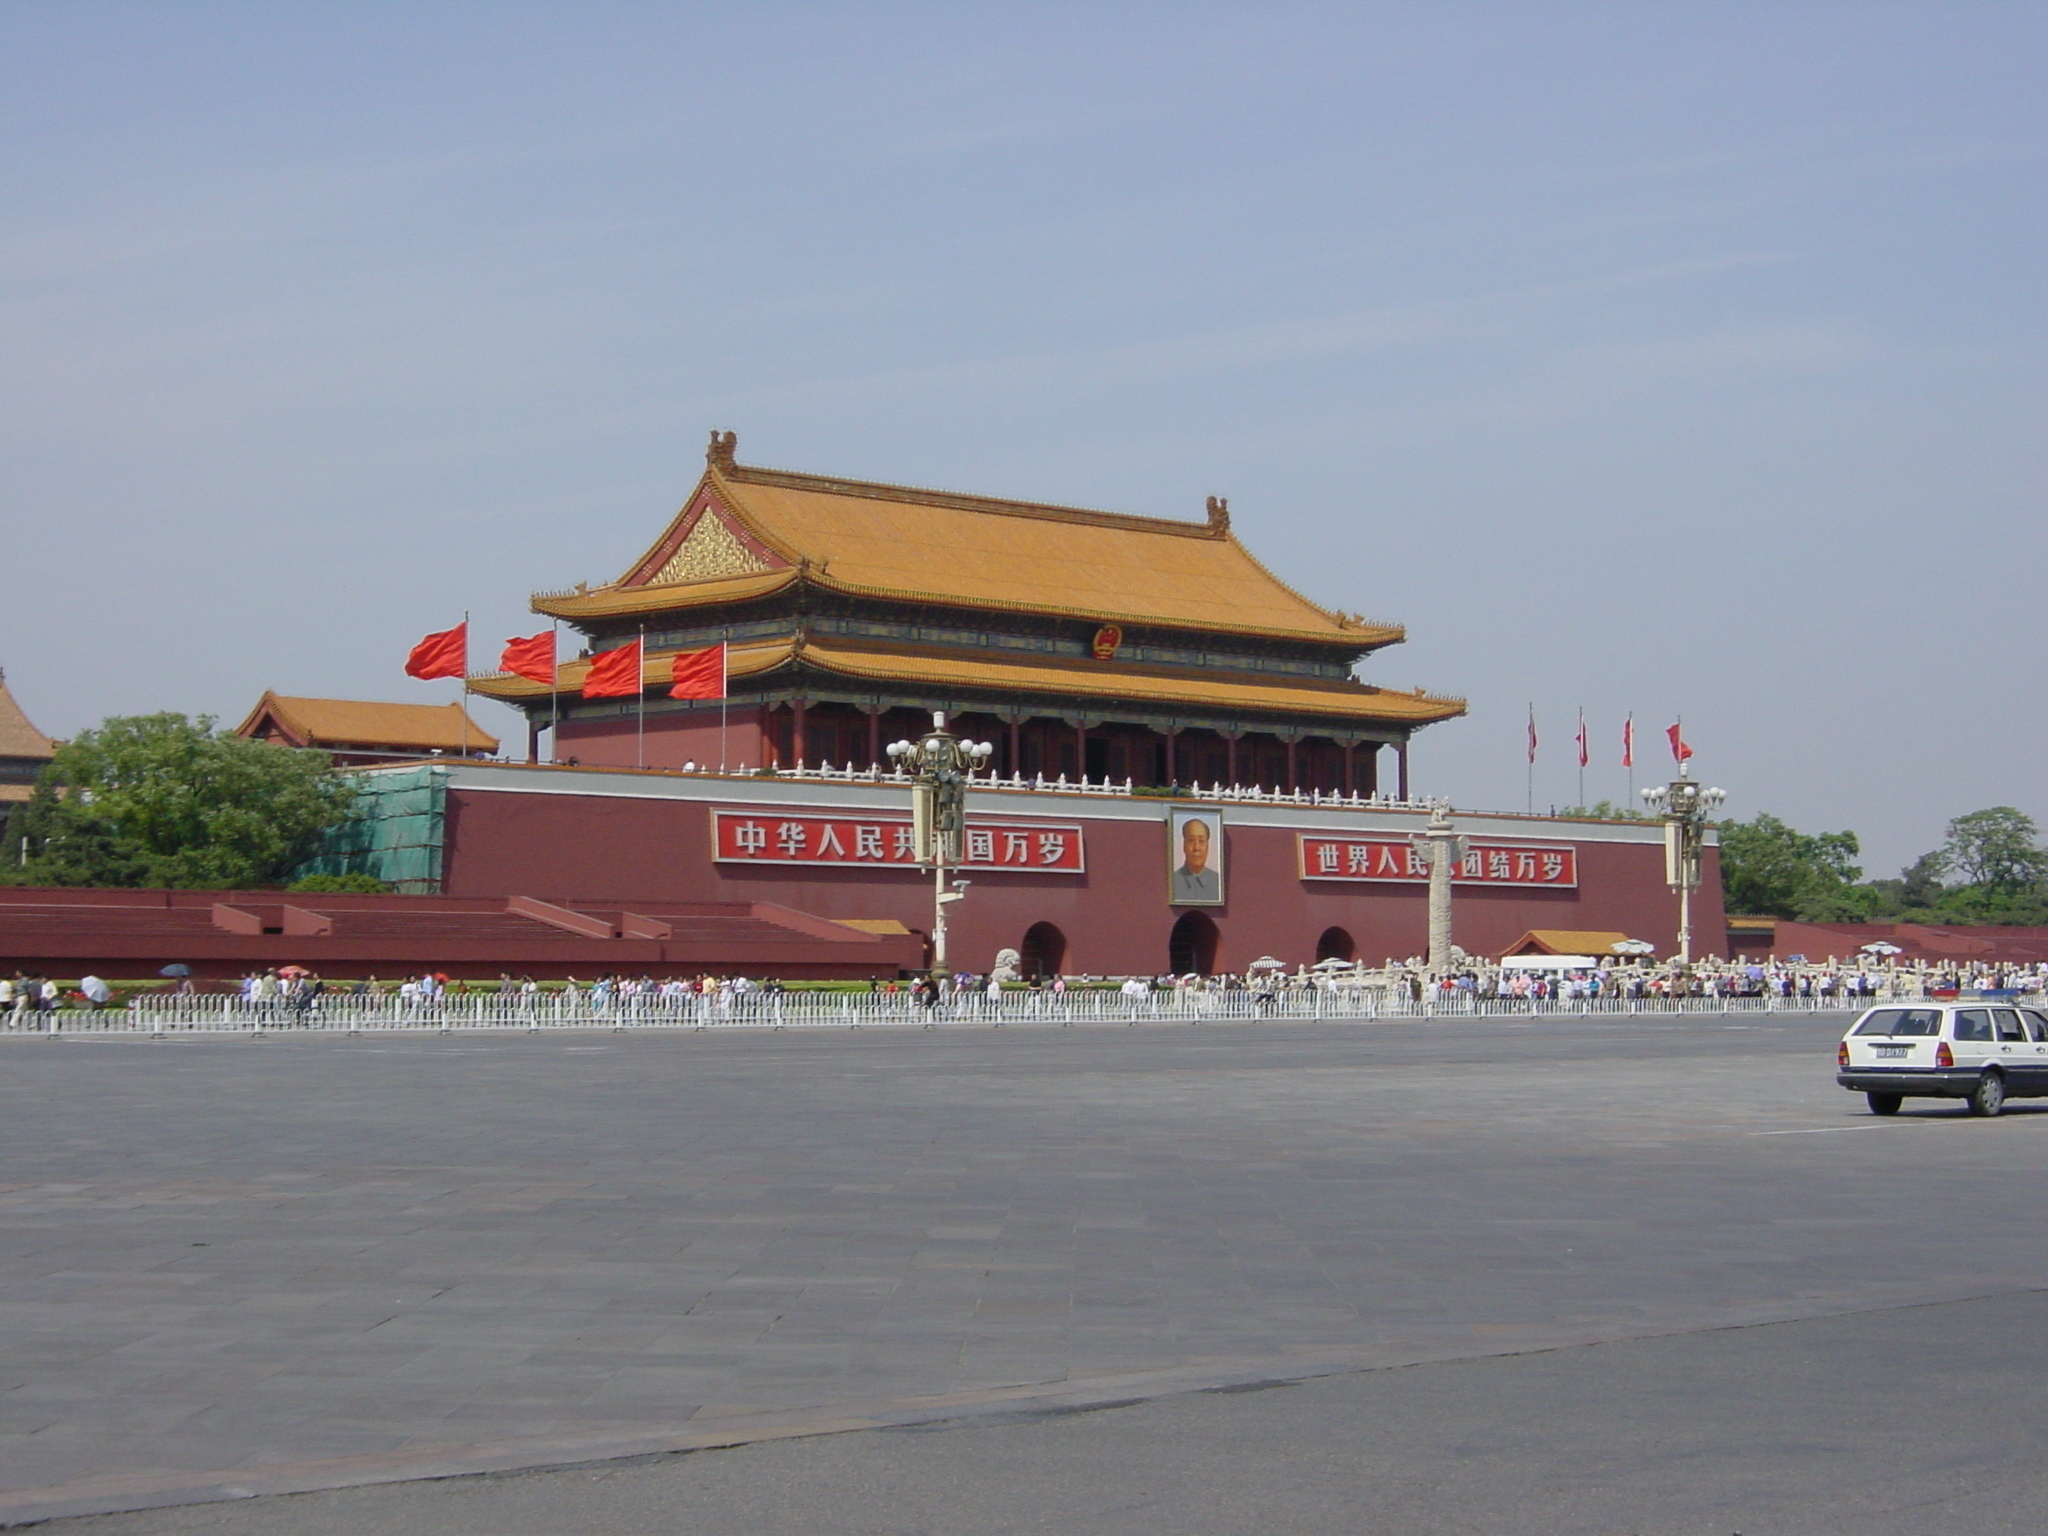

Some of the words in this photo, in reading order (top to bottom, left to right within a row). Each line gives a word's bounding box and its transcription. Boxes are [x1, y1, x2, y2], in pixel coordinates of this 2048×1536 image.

[1316, 843, 1564, 881] 世界人民团结万岁
